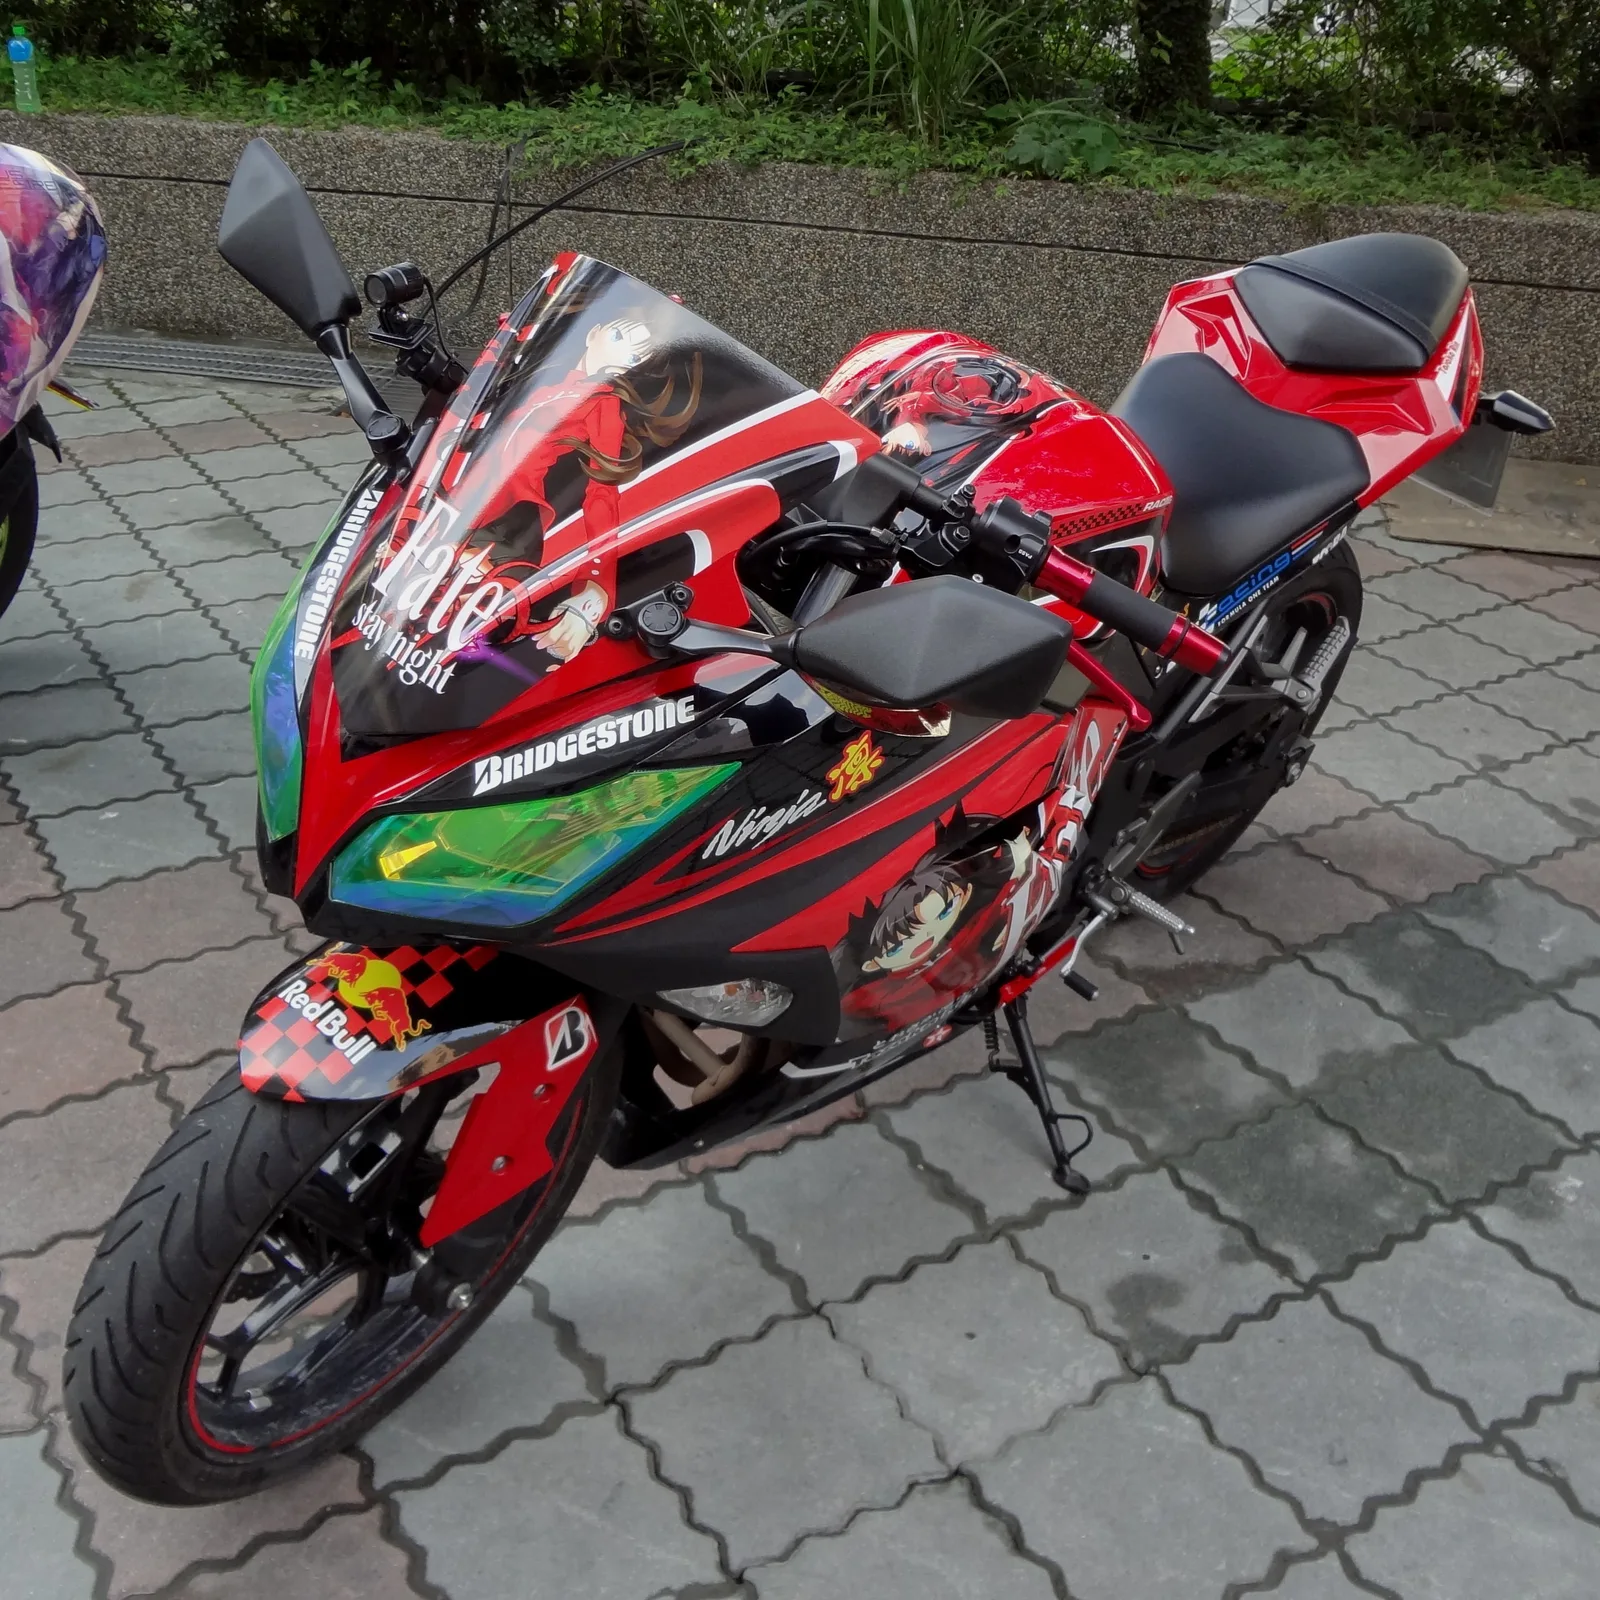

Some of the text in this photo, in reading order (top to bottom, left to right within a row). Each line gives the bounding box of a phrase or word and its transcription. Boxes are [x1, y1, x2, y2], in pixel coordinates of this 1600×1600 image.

[294, 489, 384, 660] BRIDGESTONE
[371, 496, 505, 651] Fate
[1217, 575, 1280, 627] FORMULA ONE TEAM
[350, 600, 457, 695] stay night
[472, 694, 696, 797] BRIDGESTONE
[702, 788, 827, 860] Ninja
[277, 979, 378, 1066] Red Bull
